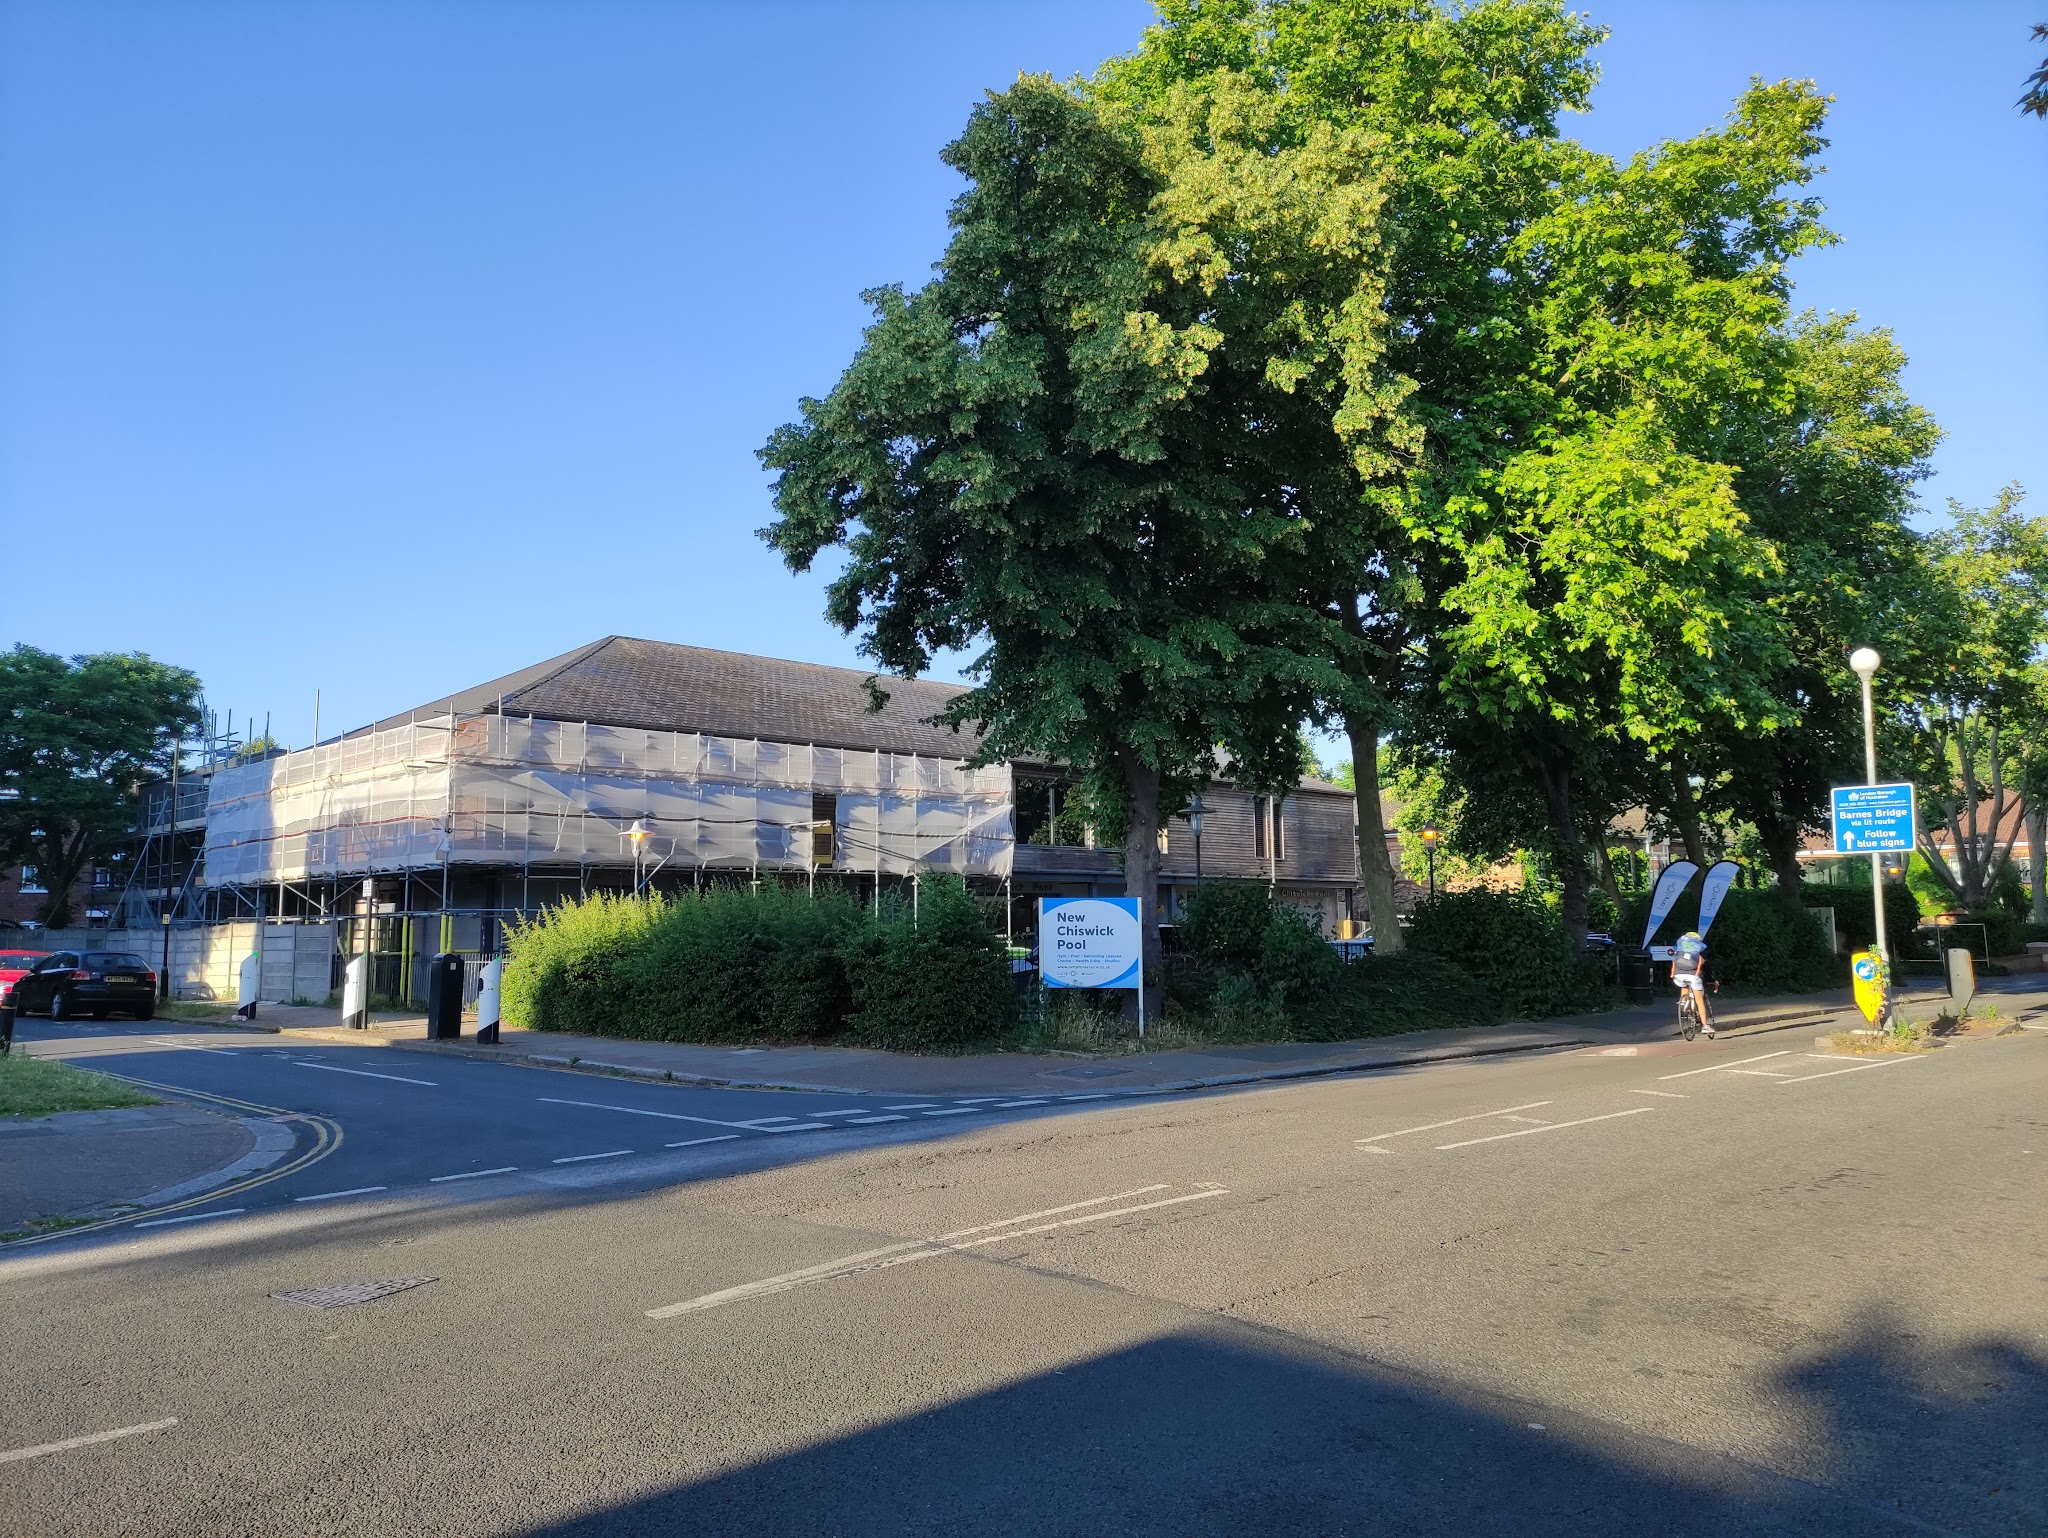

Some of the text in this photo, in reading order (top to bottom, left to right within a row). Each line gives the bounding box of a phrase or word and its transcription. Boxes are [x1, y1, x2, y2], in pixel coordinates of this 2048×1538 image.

[1840, 809, 1908, 819] Barnes Bridge
[1865, 830, 1896, 838] Follow
[1857, 839, 1905, 847] blue signs
[1057, 912, 1086, 922] New
[1057, 926, 1114, 936] Chiswick
[1057, 940, 1086, 949] Pool
